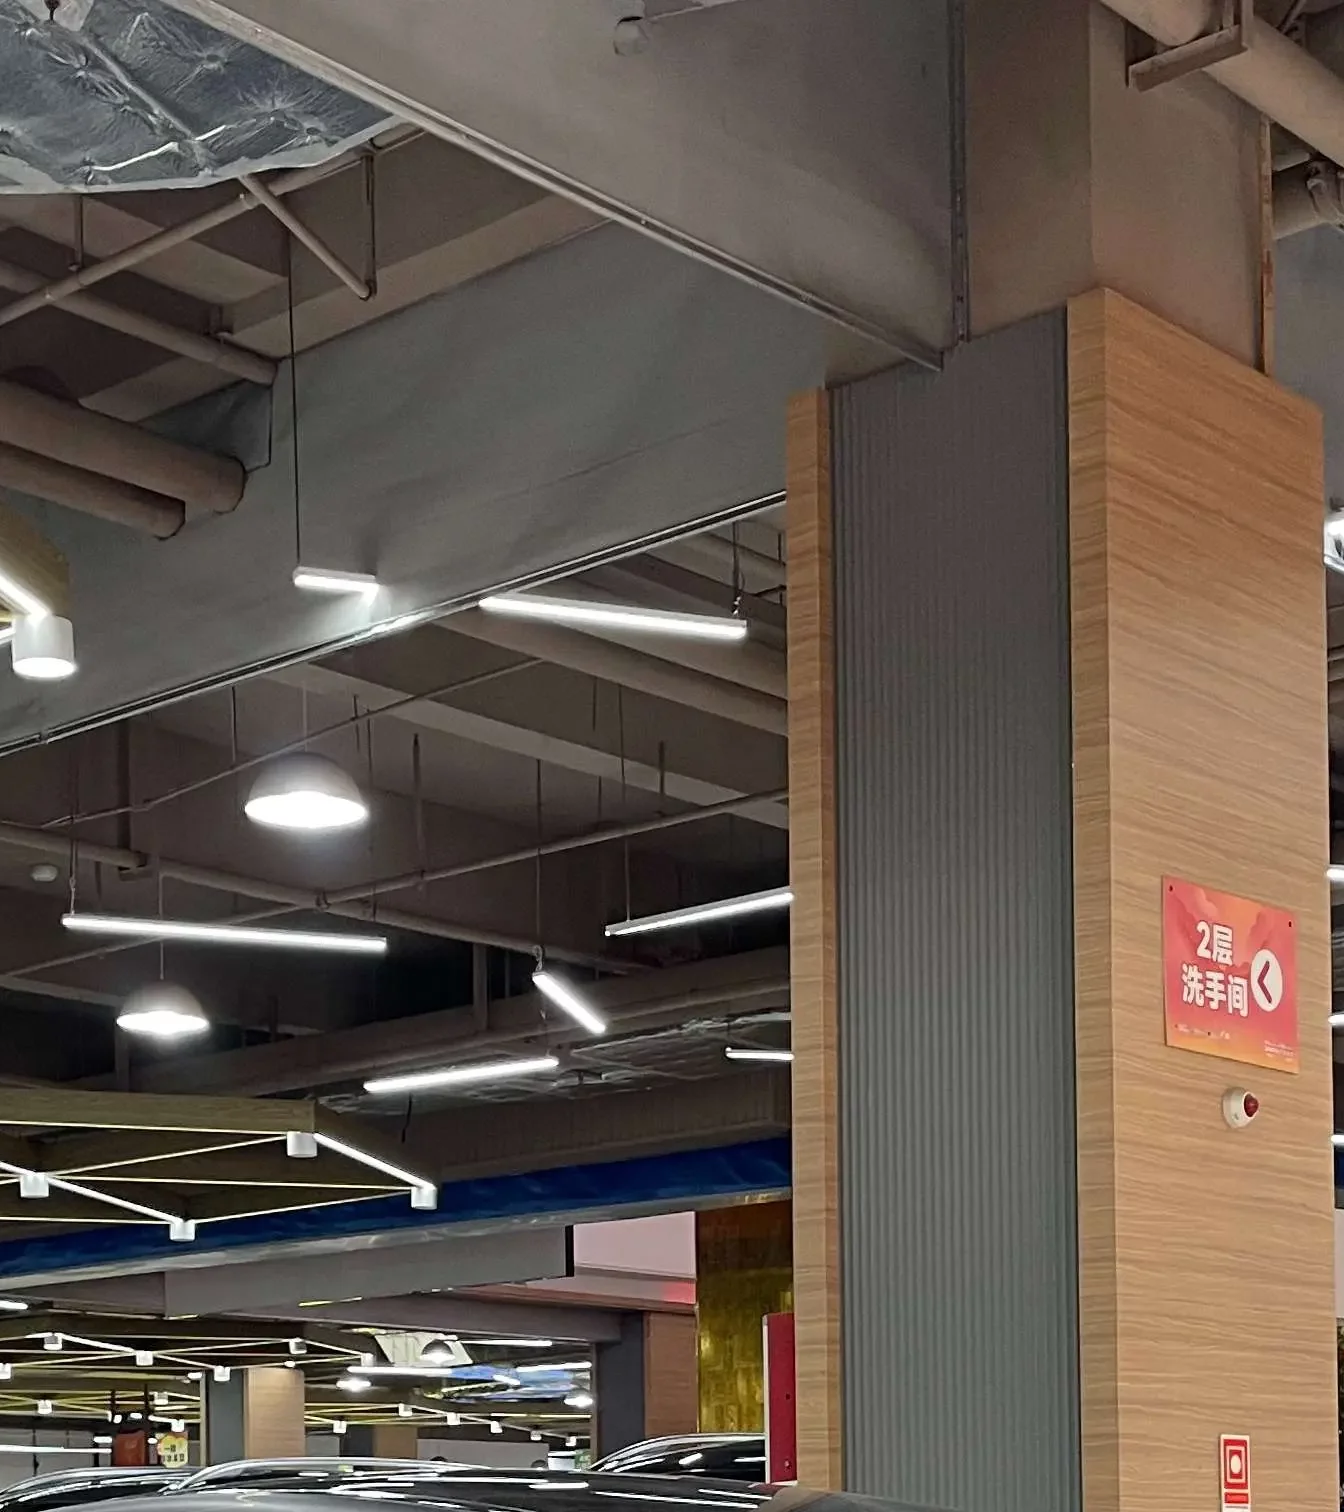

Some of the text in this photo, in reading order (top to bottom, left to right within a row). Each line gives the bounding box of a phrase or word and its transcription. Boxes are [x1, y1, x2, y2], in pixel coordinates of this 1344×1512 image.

[1196, 920, 1234, 967] 2层
[1182, 963, 1249, 1018] 洗手间
